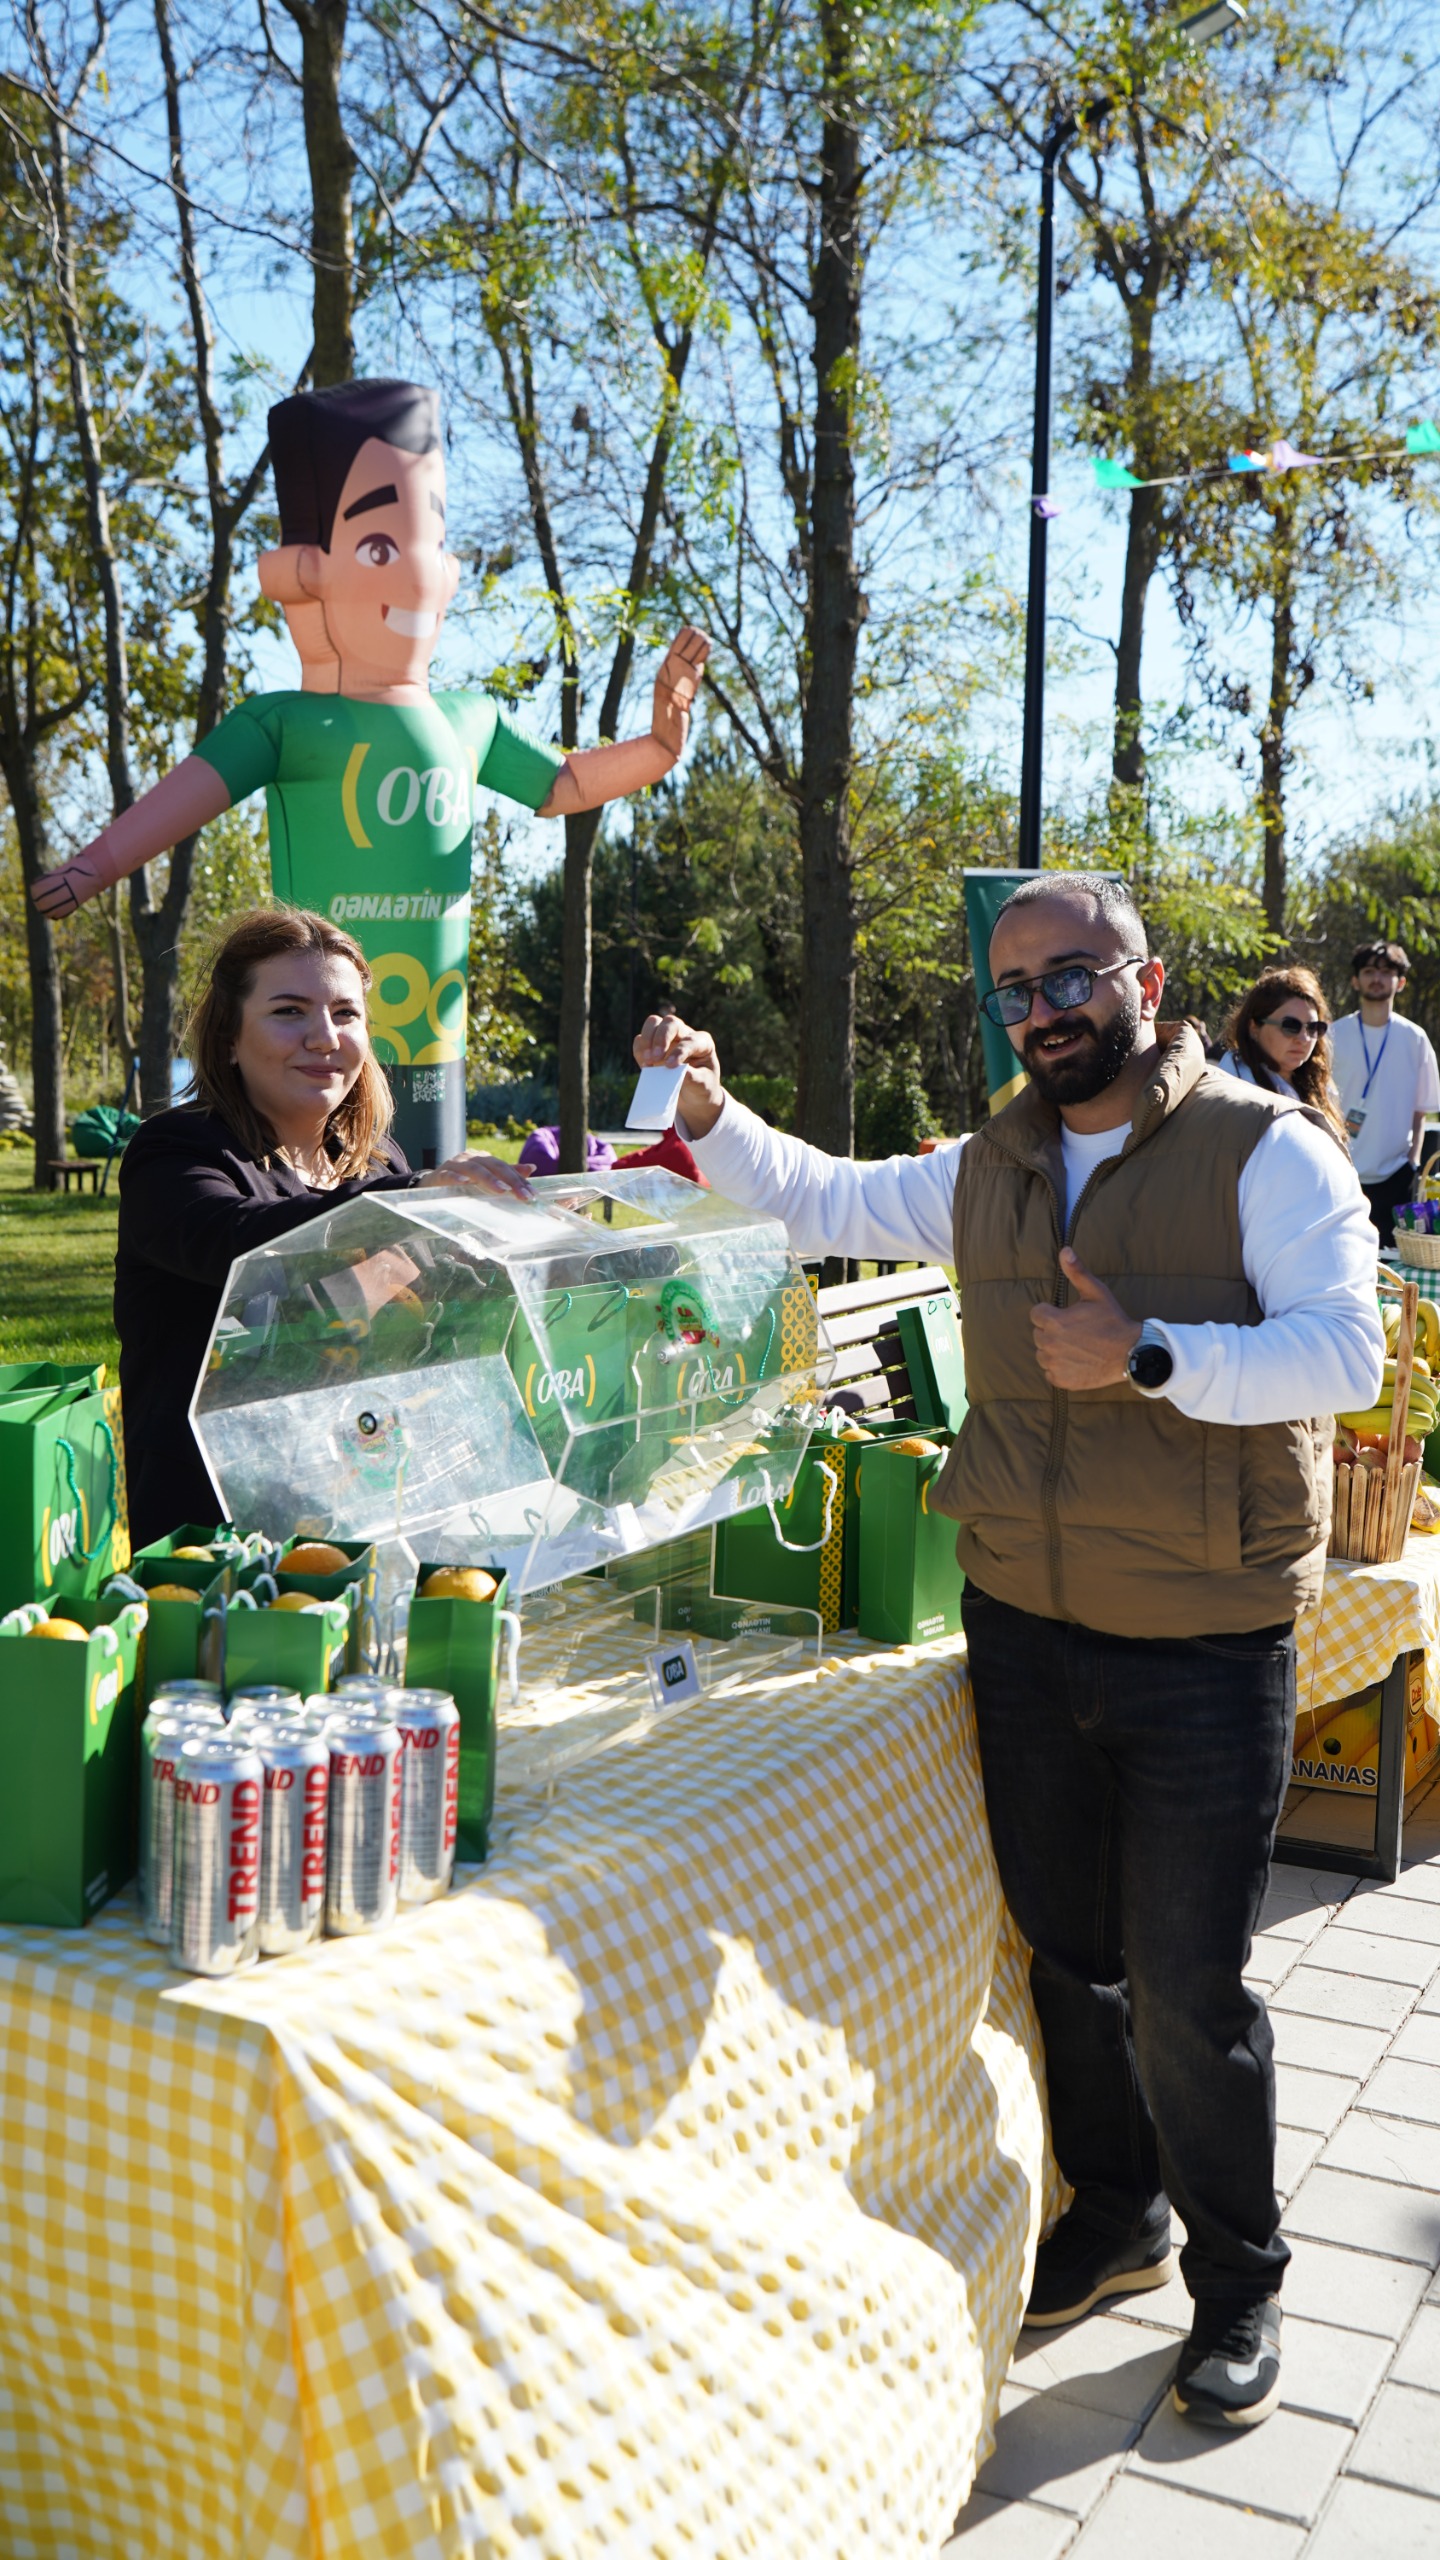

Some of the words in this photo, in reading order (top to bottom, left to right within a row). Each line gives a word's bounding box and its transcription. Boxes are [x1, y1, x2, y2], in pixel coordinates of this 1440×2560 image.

[330, 889, 443, 922] QƏNAƏTİN
[1291, 1758, 1378, 1787] NANAS
[227, 1779, 260, 1922] TREND
[301, 1764, 328, 1903] TREND
